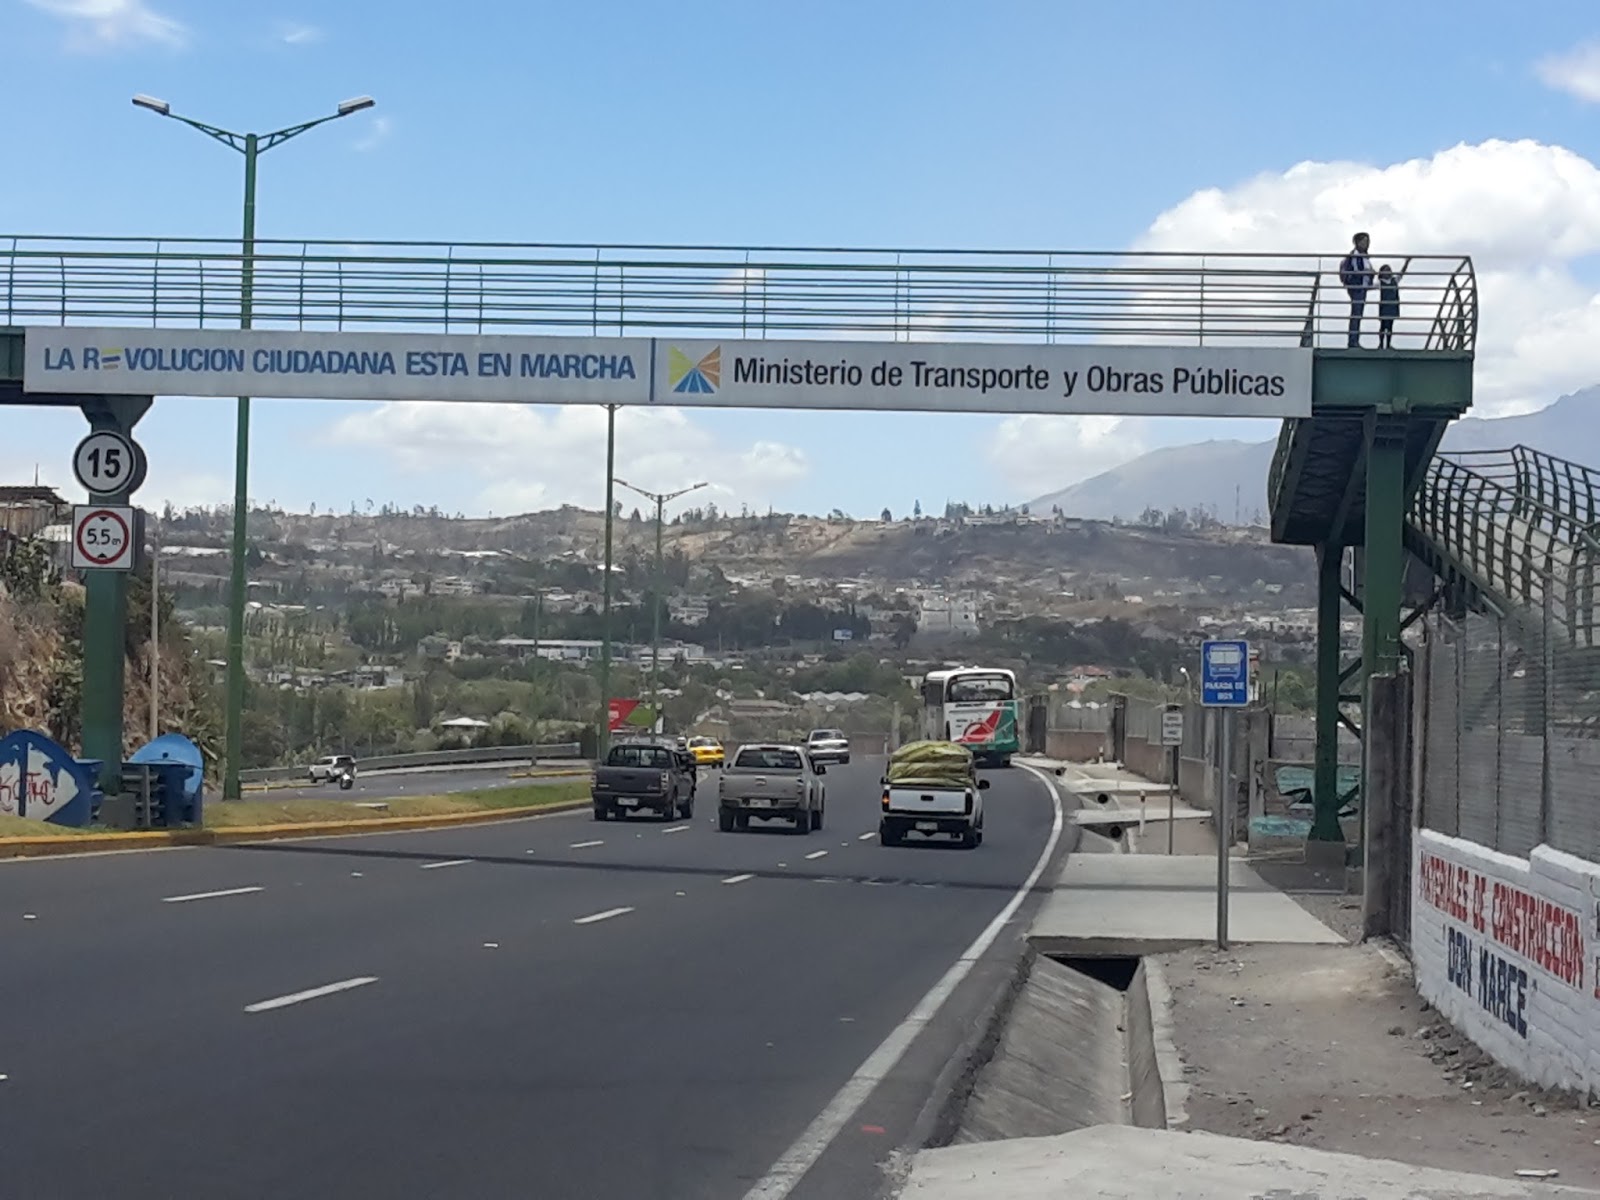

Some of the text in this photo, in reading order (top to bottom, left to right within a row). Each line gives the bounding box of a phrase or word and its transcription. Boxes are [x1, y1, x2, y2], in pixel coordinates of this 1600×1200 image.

[44, 347, 75, 370] LA
[252, 349, 396, 375] CIUDADANA
[406, 351, 469, 376] ESTA
[478, 353, 511, 377] EN
[521, 354, 636, 379] MARCHA
[734, 357, 1285, 398] Ministerio de Transporte y Obras Públicas
[87, 447, 121, 478] 15
